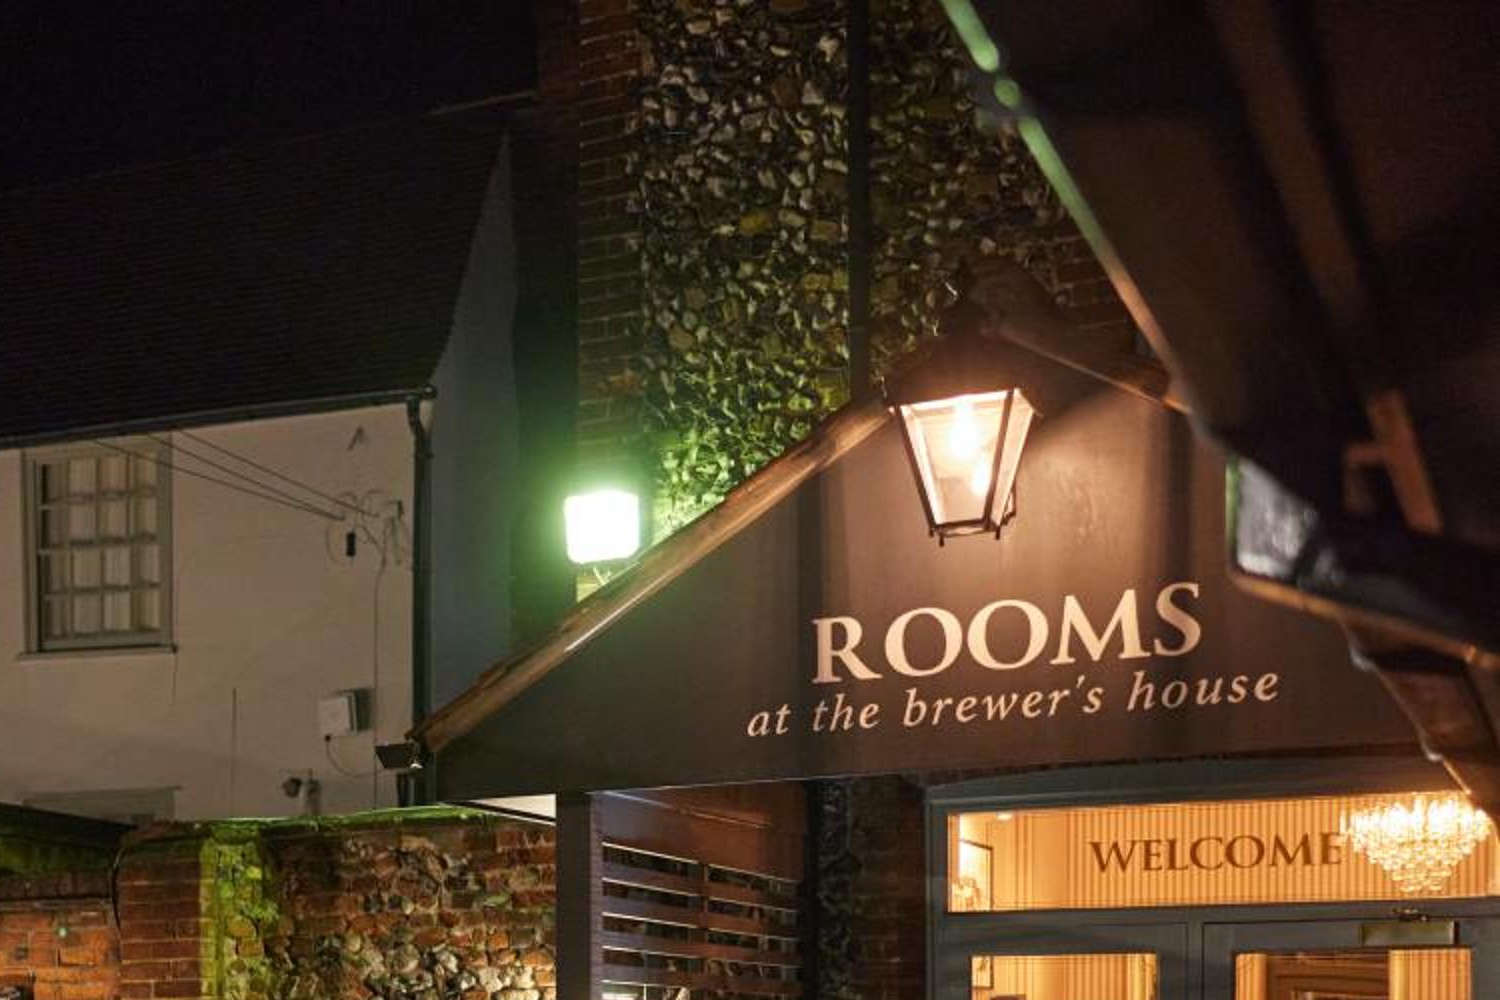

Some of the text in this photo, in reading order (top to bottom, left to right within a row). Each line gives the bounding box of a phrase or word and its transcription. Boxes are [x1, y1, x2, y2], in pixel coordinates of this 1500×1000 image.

[811, 582, 1201, 684] ROOMS
[747, 669, 1279, 737] at the brewer's house
[1088, 831, 1344, 874] WELCOME
